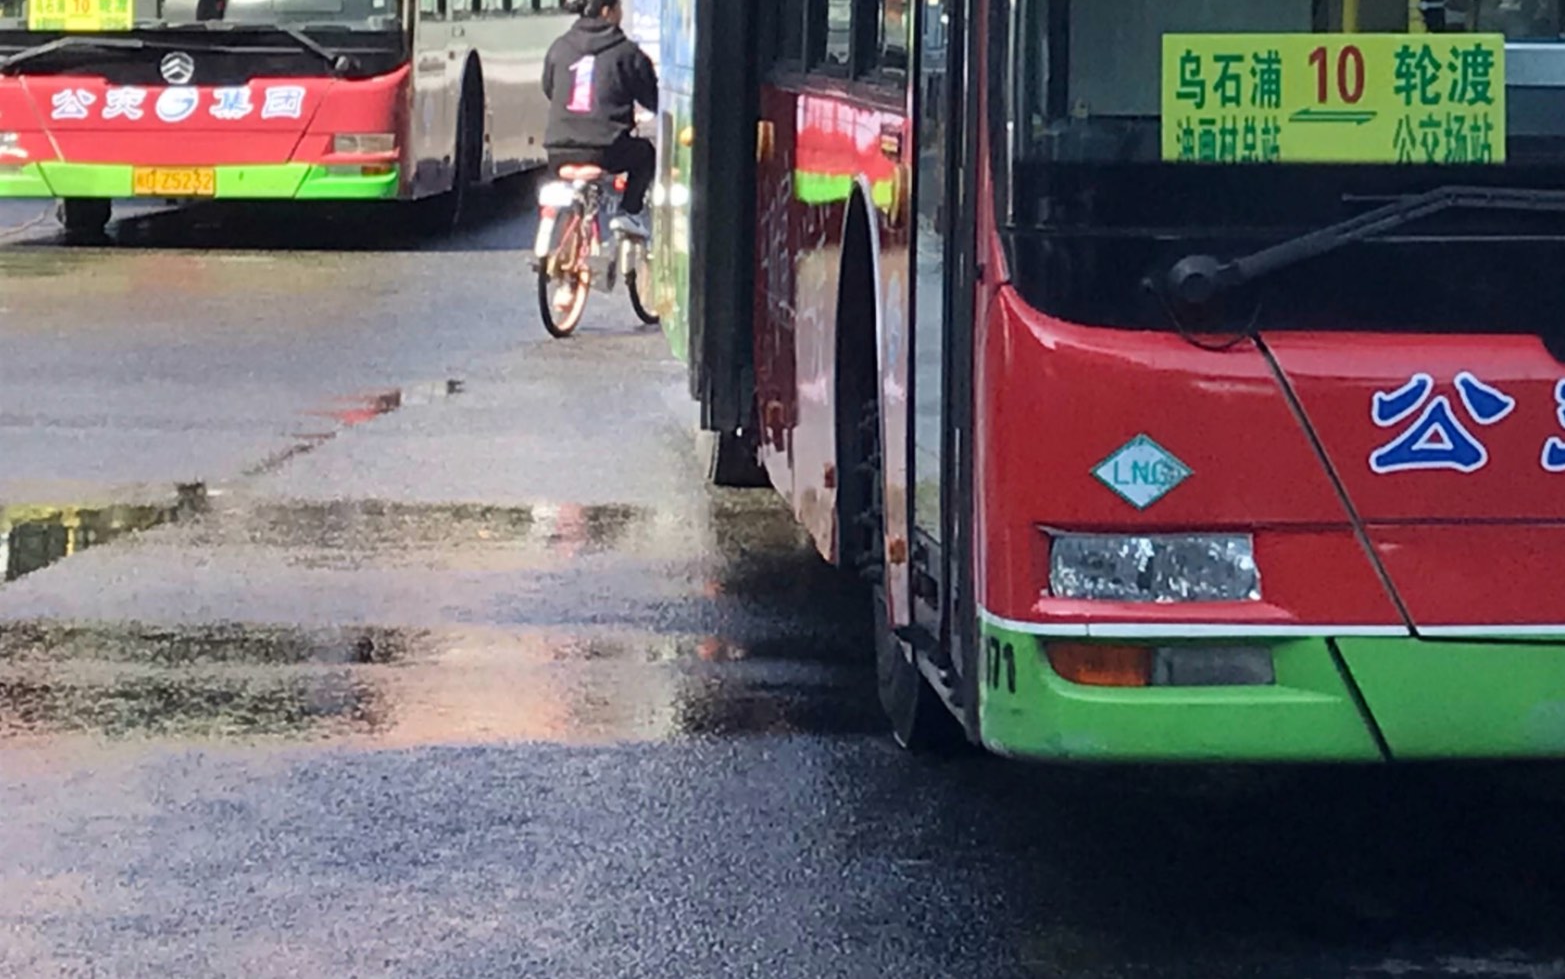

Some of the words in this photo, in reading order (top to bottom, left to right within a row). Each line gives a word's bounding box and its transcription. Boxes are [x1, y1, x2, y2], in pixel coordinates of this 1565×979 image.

[565, 53, 596, 114] 1
[1175, 49, 1282, 110] 乌石浦
[1308, 45, 1366, 104] 10
[1393, 43, 1495, 107] 轮渡
[1113, 459, 1181, 486] LNG
